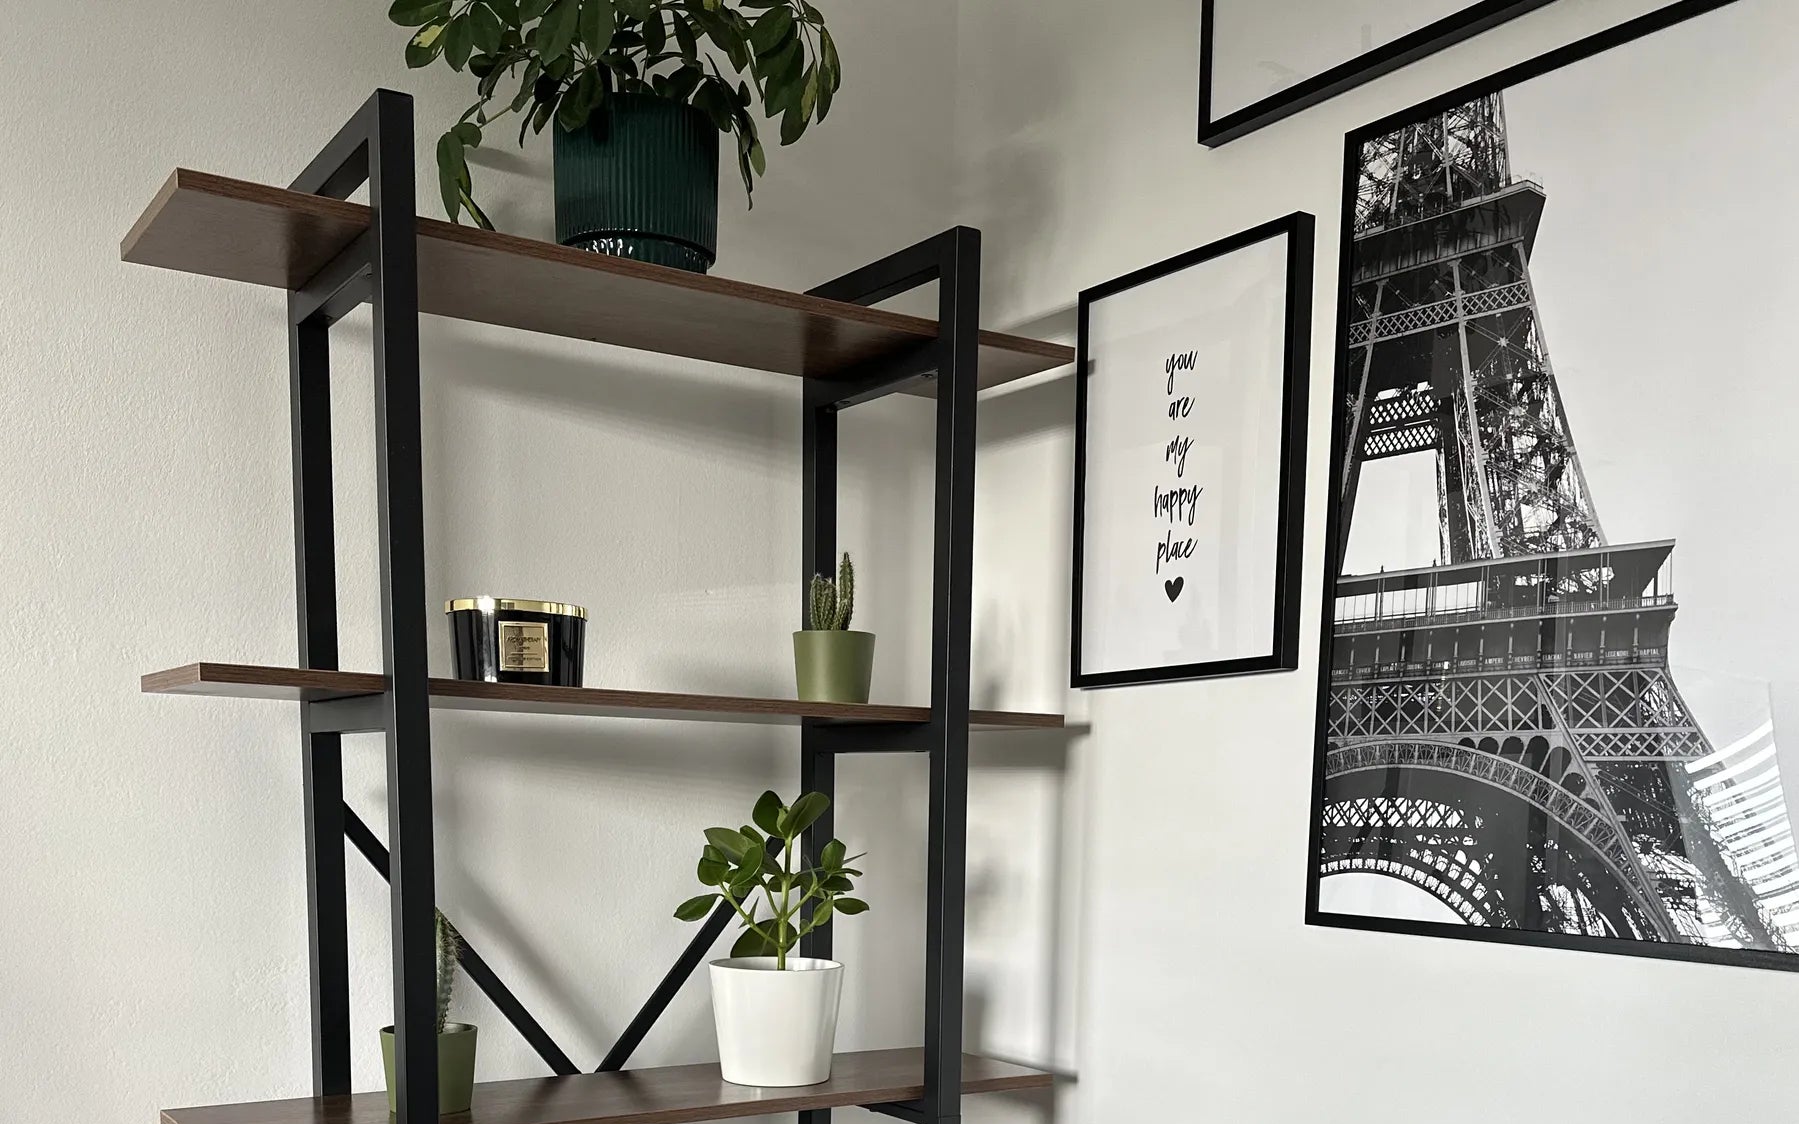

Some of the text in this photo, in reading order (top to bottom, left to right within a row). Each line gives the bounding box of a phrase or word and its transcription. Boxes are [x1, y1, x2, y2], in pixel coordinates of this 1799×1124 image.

[1165, 350, 1198, 396] you
[1168, 396, 1196, 421] are
[1165, 434, 1195, 478] my
[1154, 485, 1204, 527] happy
[1155, 529, 1198, 574] place
